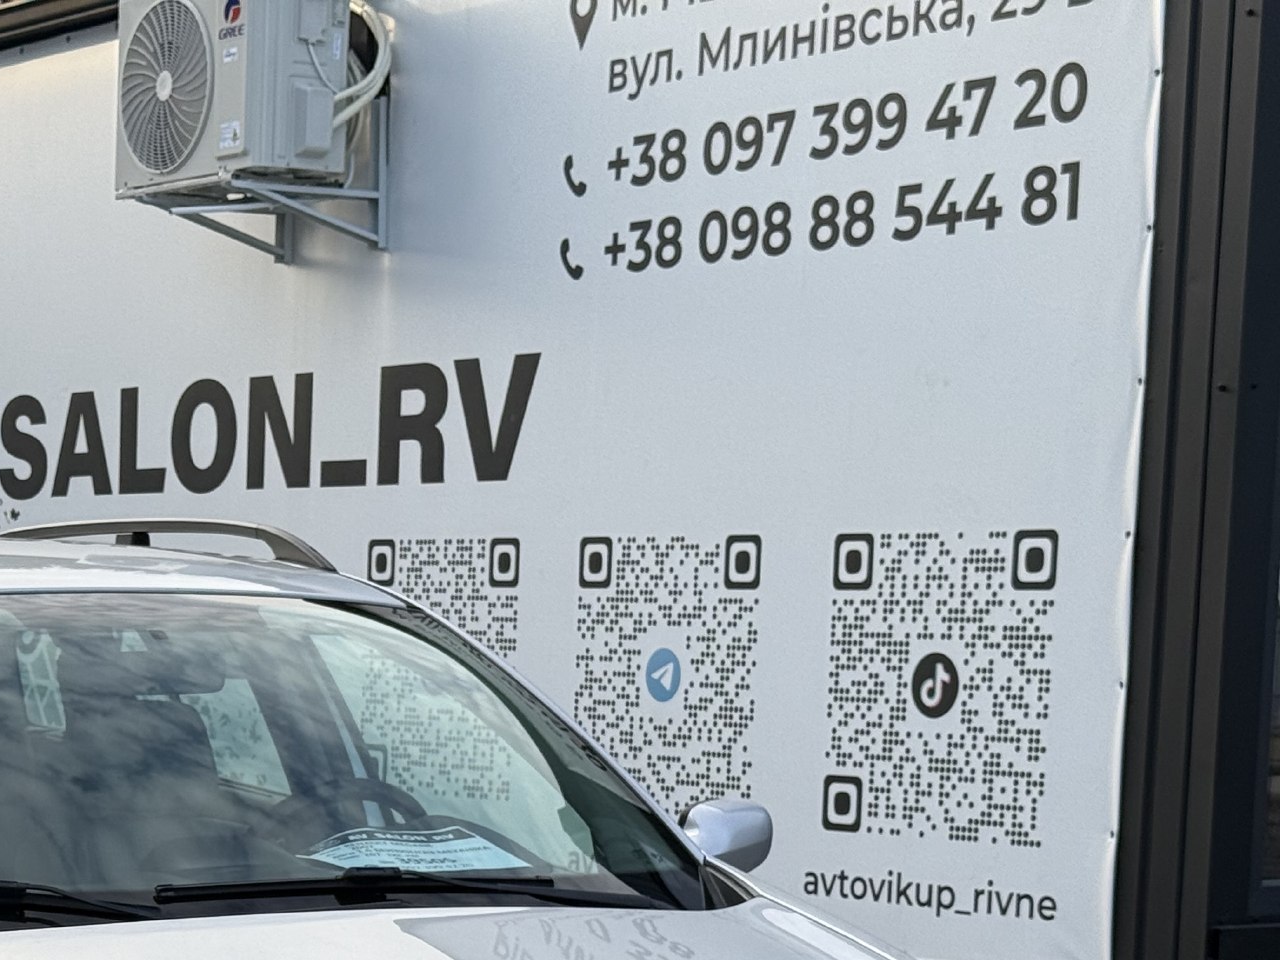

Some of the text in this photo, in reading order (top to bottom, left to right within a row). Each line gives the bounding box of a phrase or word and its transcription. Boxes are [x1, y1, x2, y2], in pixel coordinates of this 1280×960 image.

[218, 24, 245, 40] GREE
[608, 48, 683, 101] вул.
[697, 0, 976, 77] Млинівська,
[607, 61, 1088, 187] +38 097 399 47 20
[603, 160, 1081, 273] +38 098 88 544 81
[803, 869, 1058, 921] avtovikup_rivne
